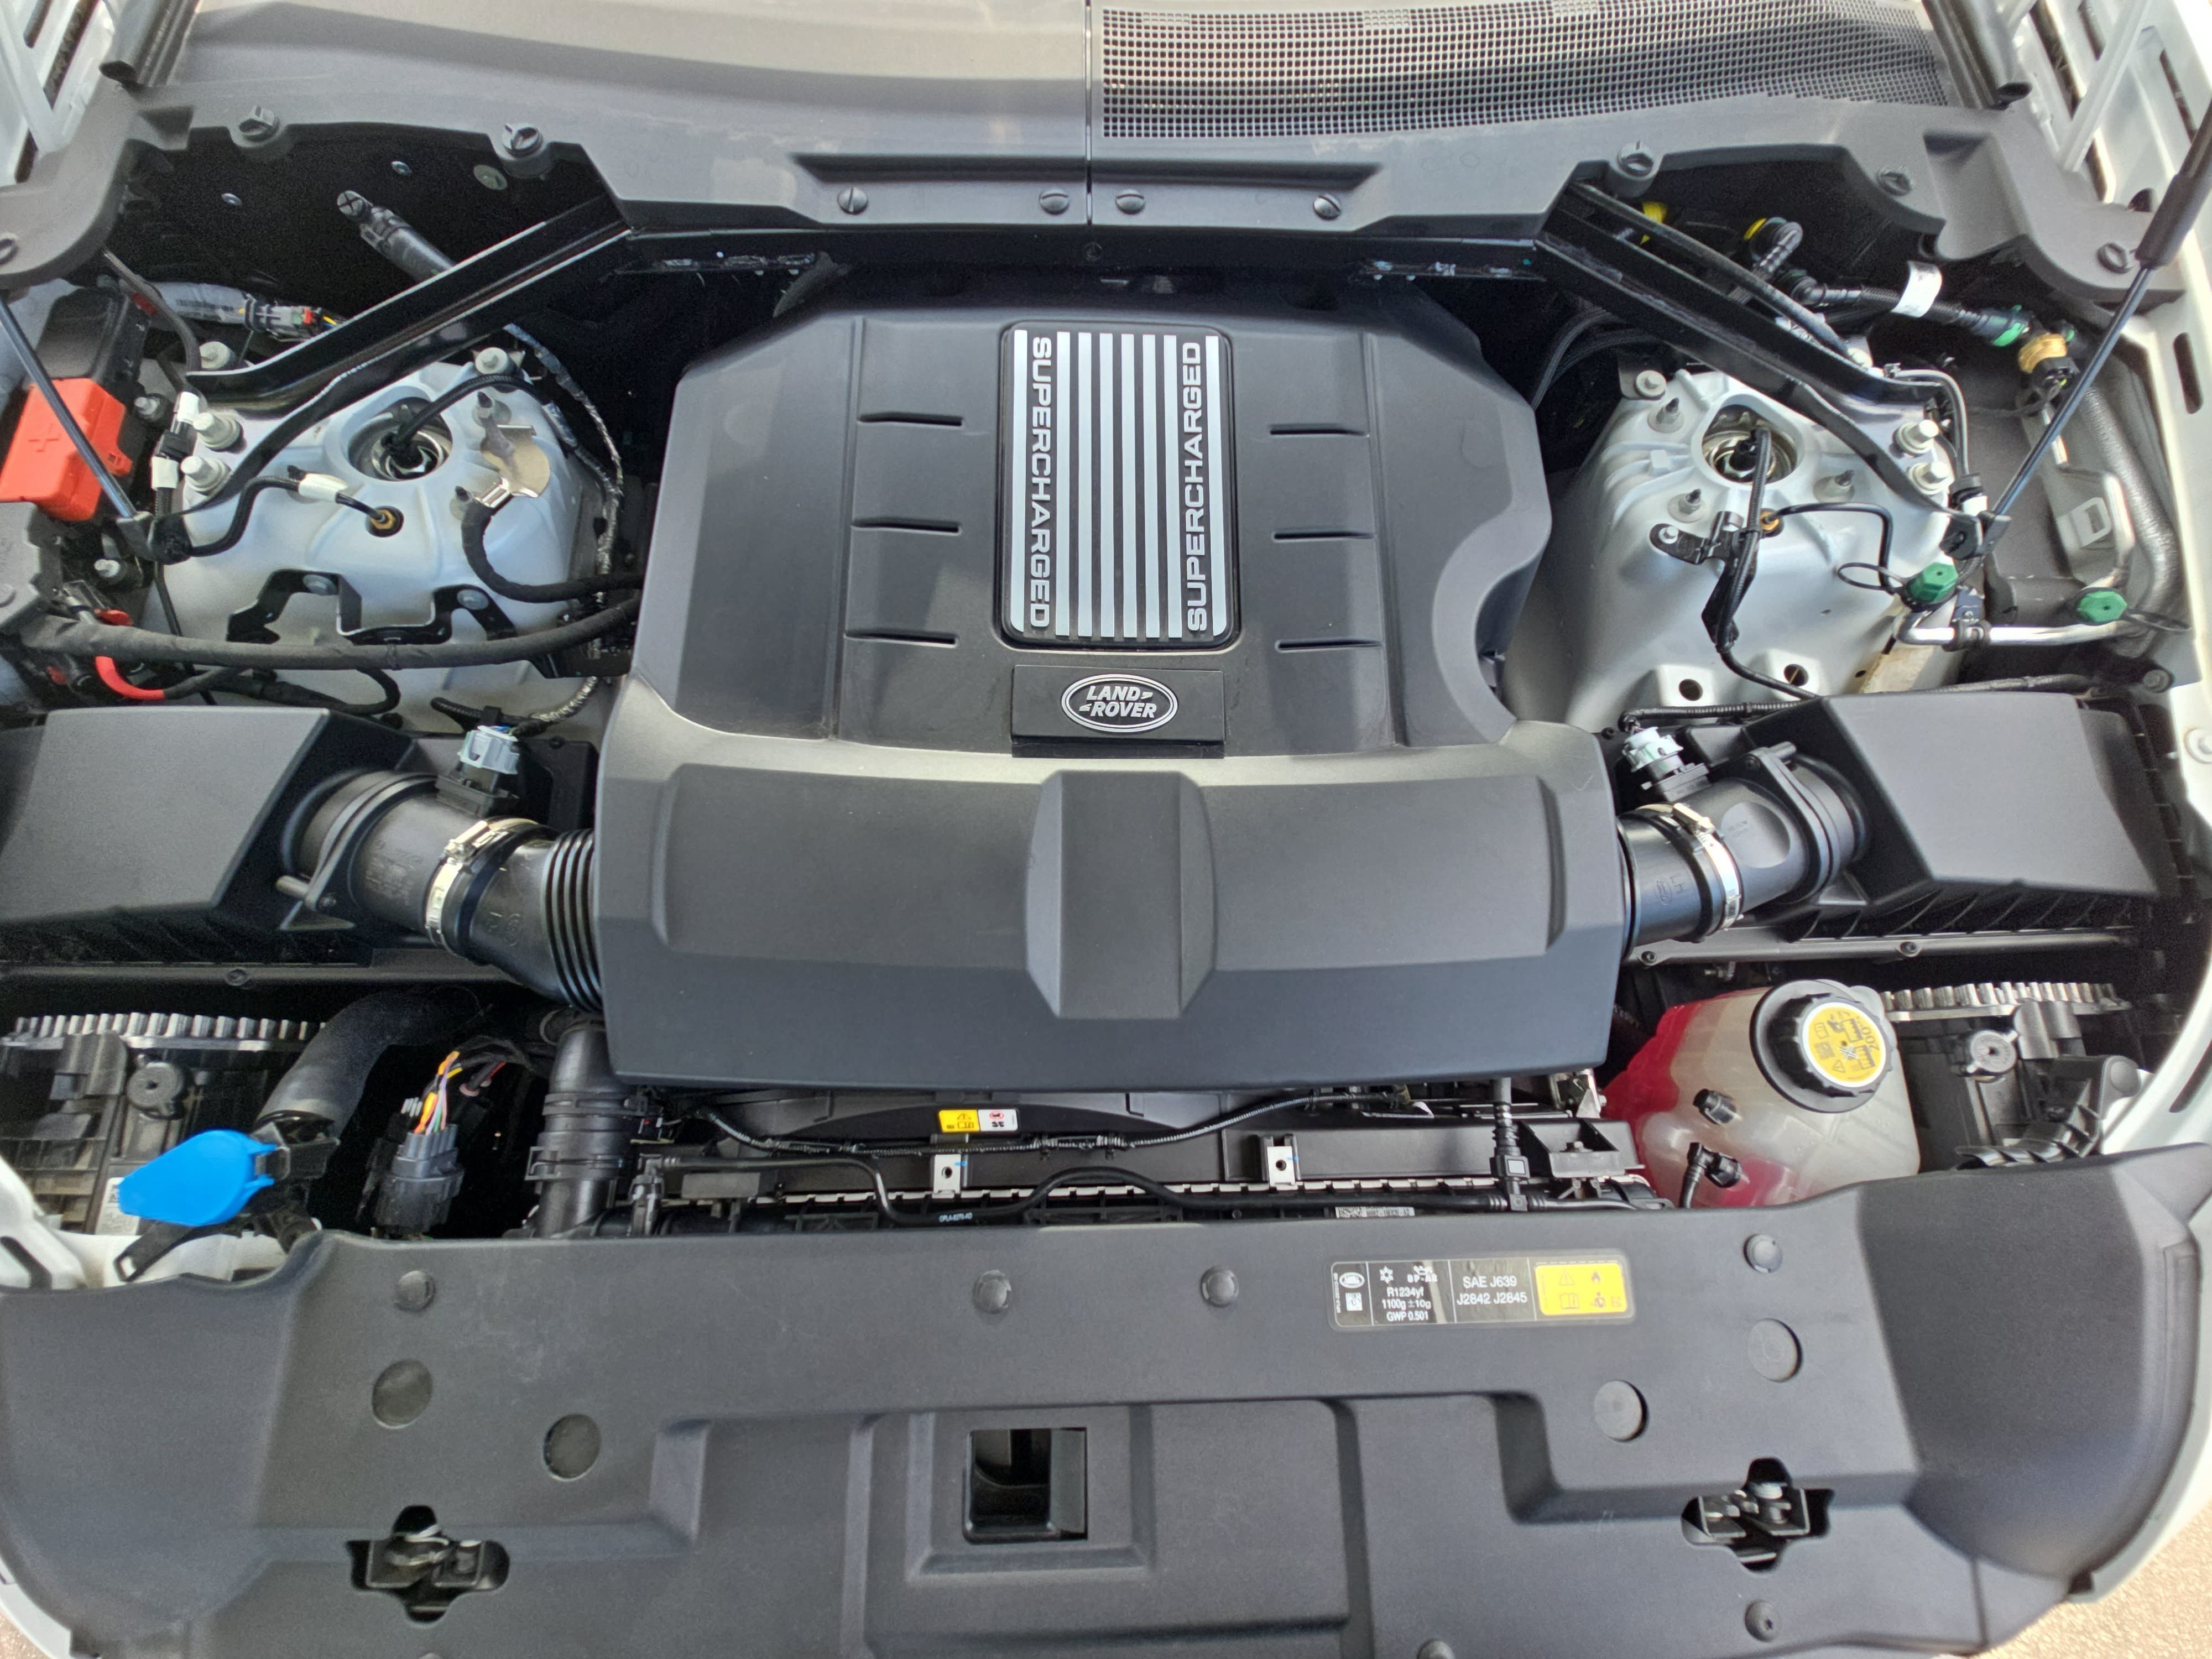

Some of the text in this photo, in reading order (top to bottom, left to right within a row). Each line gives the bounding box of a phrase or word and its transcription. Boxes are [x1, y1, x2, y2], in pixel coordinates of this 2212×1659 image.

[1031, 337, 1052, 628] SUPERCHARGED
[1182, 342, 1207, 632] SUPERCHARGED
[1086, 685, 1141, 701] LAND
[1090, 701, 1157, 718] ROVER
[1463, 1275, 1517, 1288] SAE J639
[1386, 1286, 1425, 1299] R1234yf
[1456, 1291, 1527, 1306] J2842 J2845
[1381, 1298, 1432, 1311] 1100g ±10g
[1386, 1310, 1429, 1322] GWP 0.501
